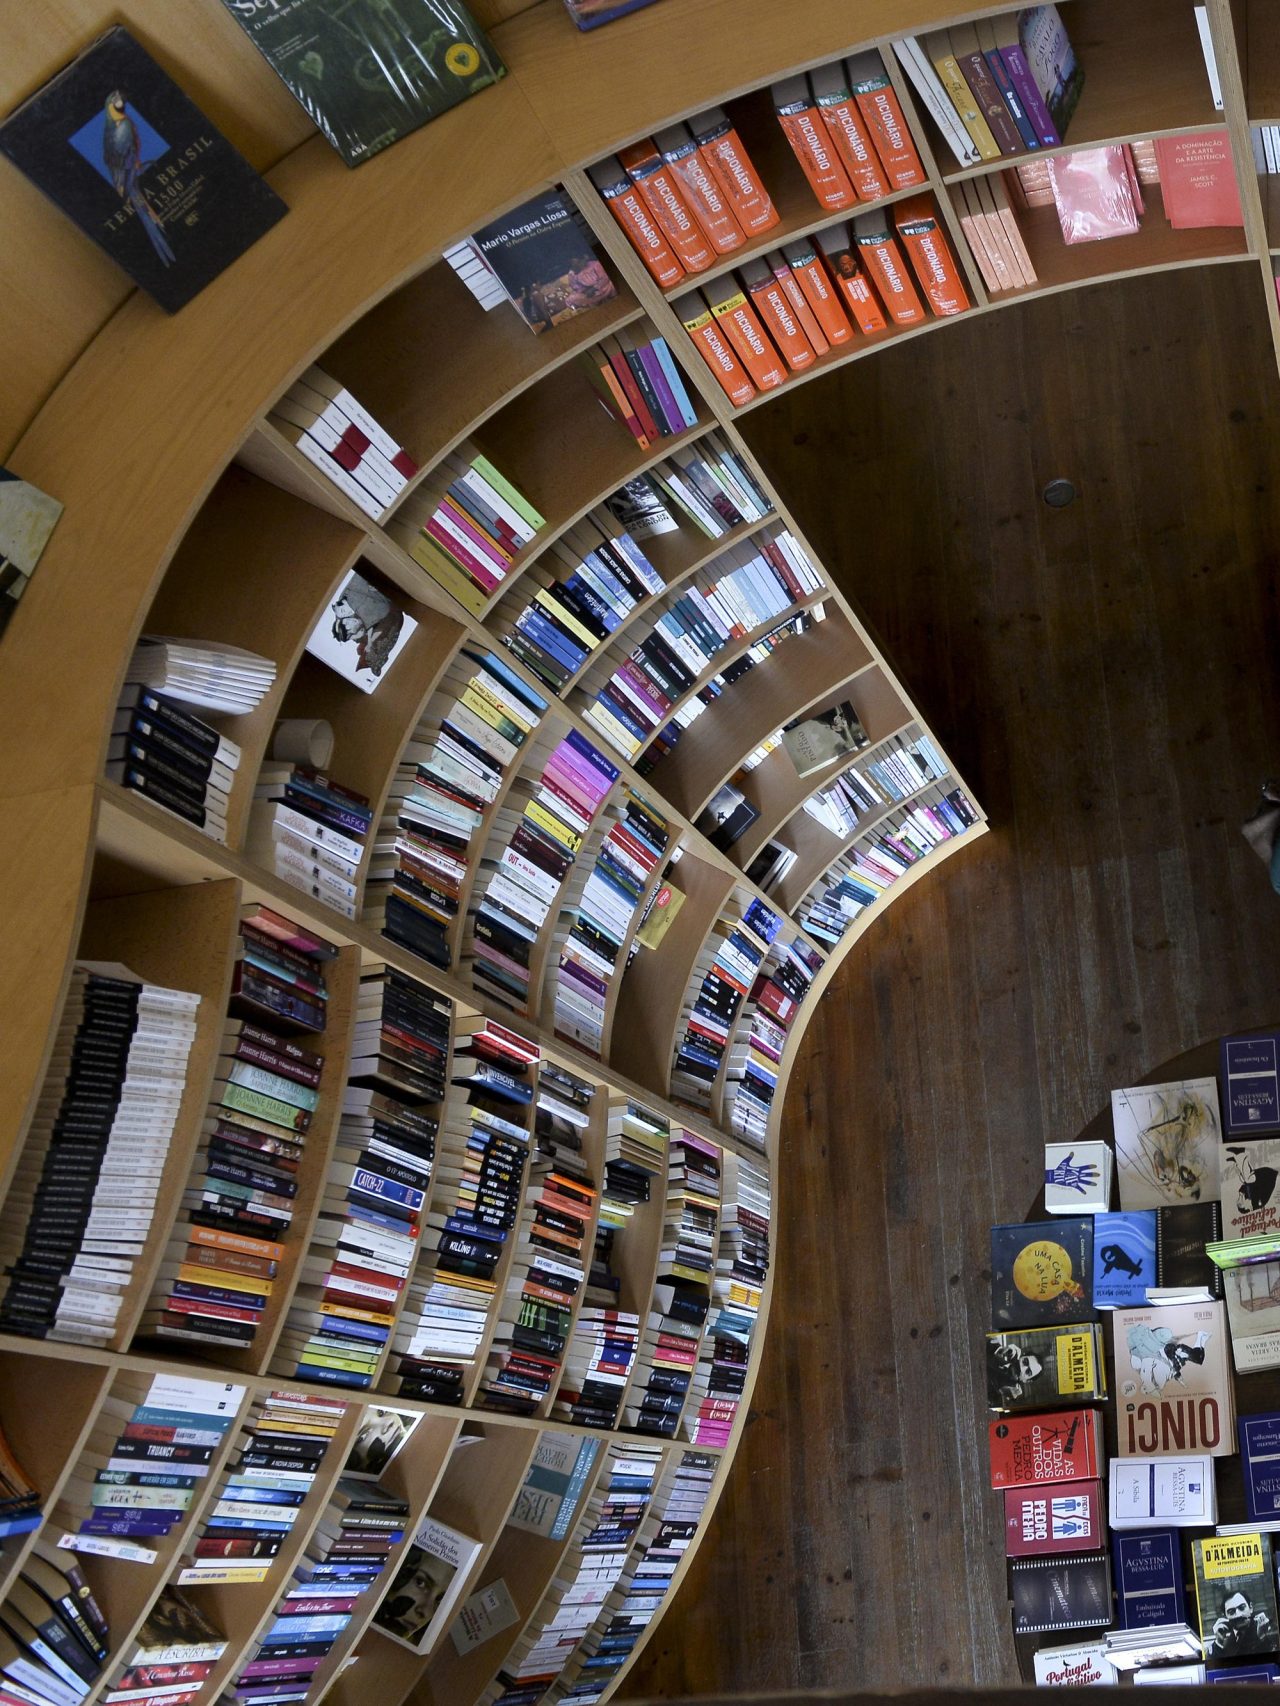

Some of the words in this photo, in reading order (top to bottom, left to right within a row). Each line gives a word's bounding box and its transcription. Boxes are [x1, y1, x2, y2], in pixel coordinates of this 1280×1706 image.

[837, 108, 868, 161] DICIONÁRIO
[875, 95, 903, 149] DICIONÁRIO
[351, 144, 368, 156] ASA
[798, 116, 830, 170] DICIONÁRIO
[1182, 140, 1222, 149] DOMINAÇÃO
[104, 186, 155, 231] TERA
[157, 136, 213, 186] BRASIL
[720, 141, 753, 195] DICIONÁRIO
[154, 180, 184, 208] 1500
[687, 160, 722, 212] DICIONÁRIO
[654, 177, 690, 231] DICIONÁRIO
[481, 232, 508, 251] Mario
[507, 220, 540, 238] Vargas
[541, 209, 567, 224] Llosa
[624, 196, 660, 248] DICIONÁRIO
[876, 248, 904, 293] DICIONÁRIO
[920, 238, 947, 283] DICIONÁRIO
[808, 268, 828, 300] DICIONÁRIO
[767, 292, 796, 336] DICIONÁRIO
[703, 328, 734, 372] DICIONÁRIO
[733, 310, 764, 355] DICIONÁRIO
[340, 812, 365, 831] KAFKA
[508, 853, 519, 866] OUT
[242, 1025, 260, 1039] Joanne
[261, 1032, 276, 1045] Harris
[239, 1043, 260, 1057] Joanne
[260, 1050, 276, 1064] Harris
[357, 1173, 384, 1192] CATCH-22
[1231, 1207, 1276, 1226] definitivo
[450, 1242, 471, 1255] KILLING
[1034, 1250, 1052, 1261] UMA
[1052, 1262, 1062, 1285] CASA
[1035, 1262, 1044, 1276] NA
[1039, 1277, 1048, 1294] LUA
[1072, 1337, 1084, 1390] D'ALMEIDA
[1128, 1398, 1220, 1453] OINC!
[147, 1445, 175, 1457] TRUANCY
[1013, 1440, 1022, 1481] MEXIA
[1022, 1436, 1032, 1480] PEDRO
[1032, 1425, 1043, 1479] OUTROS
[1043, 1449, 1052, 1478] DOS
[1053, 1439, 1063, 1477] VIDAS
[1064, 1460, 1074, 1475] AS
[1022, 1501, 1034, 1541] MEXIA
[1034, 1500, 1047, 1539] PEDRO
[420, 1531, 427, 1539] A
[429, 1534, 448, 1549] Solidão
[448, 1545, 458, 1556] dos
[440, 1548, 459, 1565] Primos
[1206, 1544, 1259, 1562] D'ALMEIDA
[1126, 1556, 1168, 1567] AGVSTINA
[166, 1647, 205, 1660] ESCRIBA
[1046, 1657, 1092, 1684] Portugal
